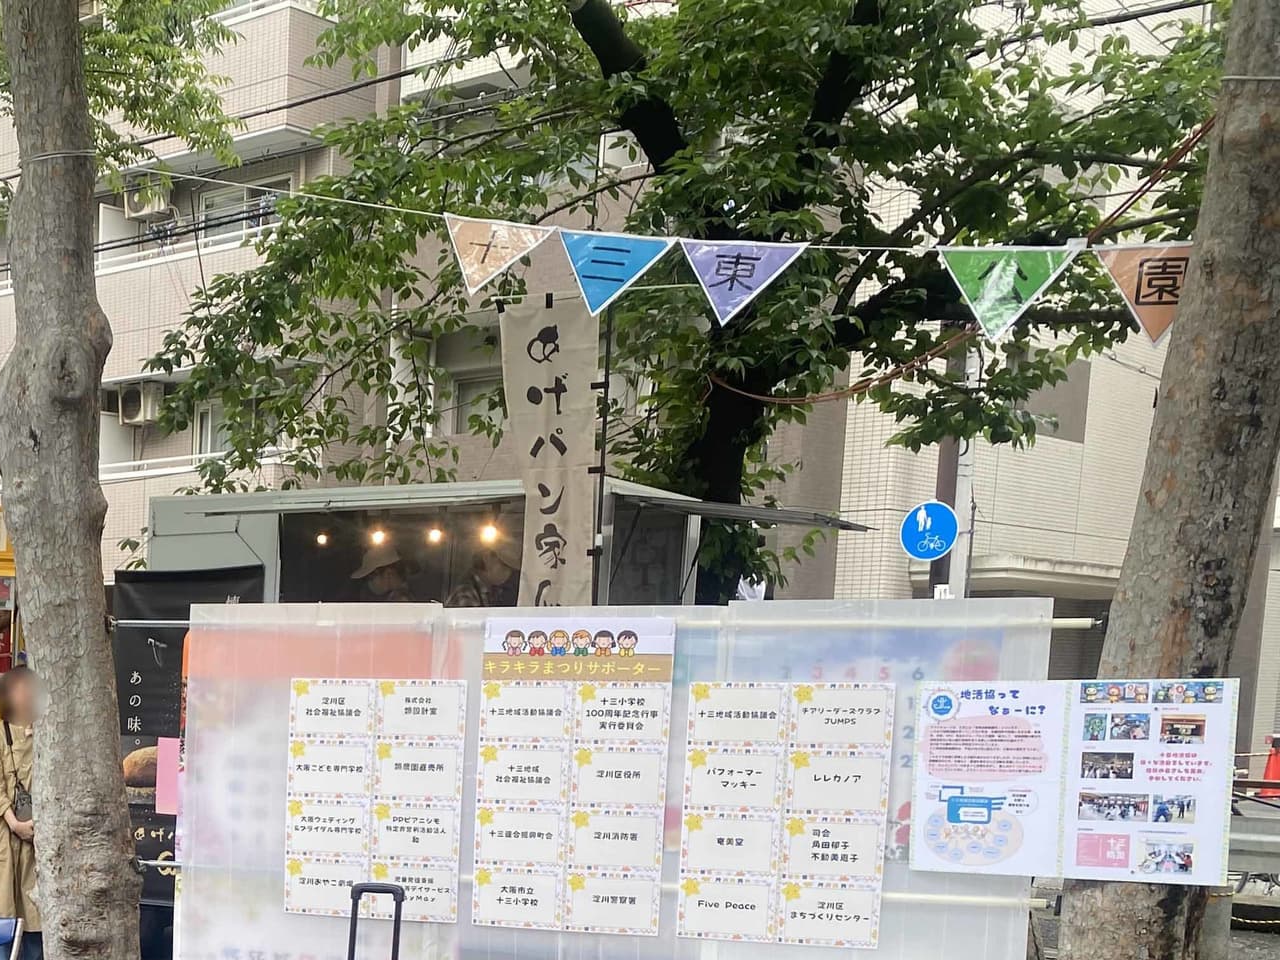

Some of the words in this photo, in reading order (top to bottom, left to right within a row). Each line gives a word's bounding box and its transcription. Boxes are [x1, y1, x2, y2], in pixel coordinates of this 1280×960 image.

[582, 246, 631, 283] 三
[709, 252, 761, 291] 東
[1135, 257, 1189, 305] 園
[484, 660, 662, 676] キラキラまつりサポーター
[600, 697, 646, 706] 十三小学校
[585, 709, 659, 719] 100周年記念行事
[697, 710, 778, 720] 十三地域活動協議会
[824, 717, 857, 726] JUMPS
[296, 763, 364, 773] 大阪こども専門学校
[507, 764, 540, 773] 十三地域
[596, 769, 641, 779] 淀川区役所
[720, 780, 757, 789] マッキー
[500, 885, 535, 895] 大阪市立
[496, 897, 539, 907] 十三小学校
[697, 899, 720, 909] Five
[725, 901, 757, 911] Peace
